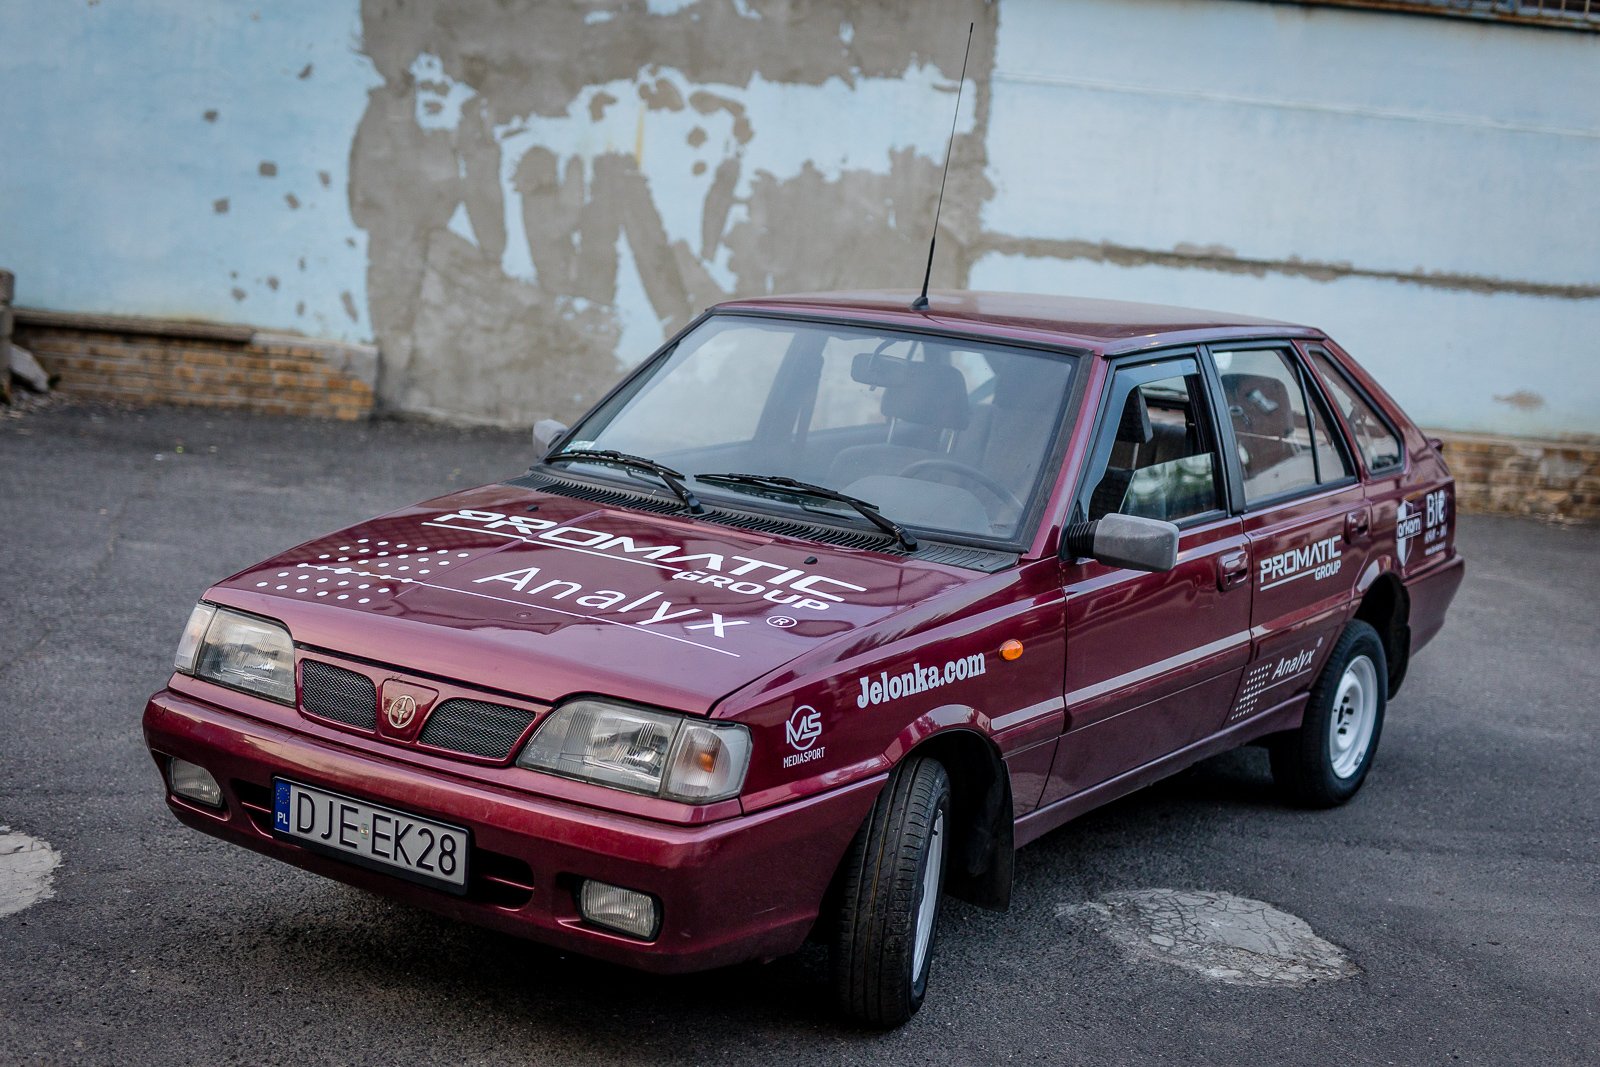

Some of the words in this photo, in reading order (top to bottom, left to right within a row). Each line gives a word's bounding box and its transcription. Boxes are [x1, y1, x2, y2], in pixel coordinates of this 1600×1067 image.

[433, 509, 868, 603] PROMATIC
[1260, 535, 1342, 583] PROMATIC
[1315, 561, 1341, 581] GROUP
[472, 567, 750, 638] Analyx
[672, 570, 830, 611] GROUP
[857, 652, 986, 709] Jelonka.com
[1271, 649, 1316, 680] Analyx
[786, 712, 822, 744] MS
[783, 746, 826, 769] MEDIASPORT
[277, 811, 288, 825] PL
[296, 791, 359, 849] DJE
[371, 813, 457, 876] EK28
